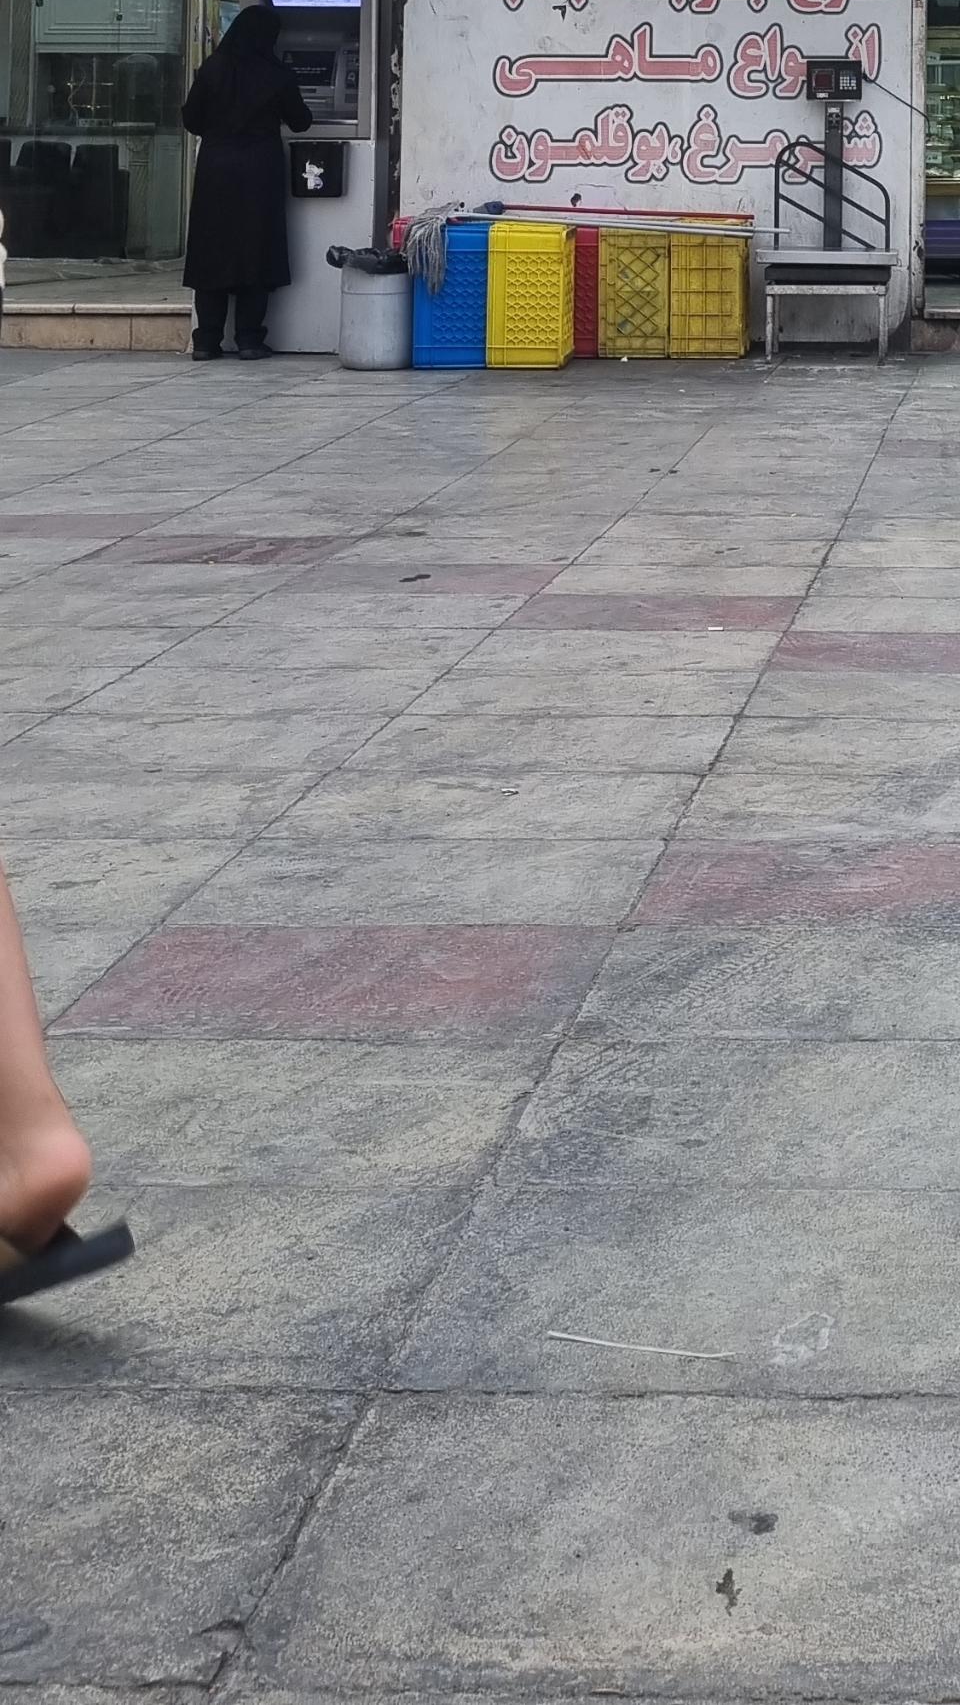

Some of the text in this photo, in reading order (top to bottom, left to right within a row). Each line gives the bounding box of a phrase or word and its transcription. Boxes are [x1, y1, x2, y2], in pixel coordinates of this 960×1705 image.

[492, 21, 882, 99] انواع ماهی
[489, 103, 674, 184] بوقلمون
